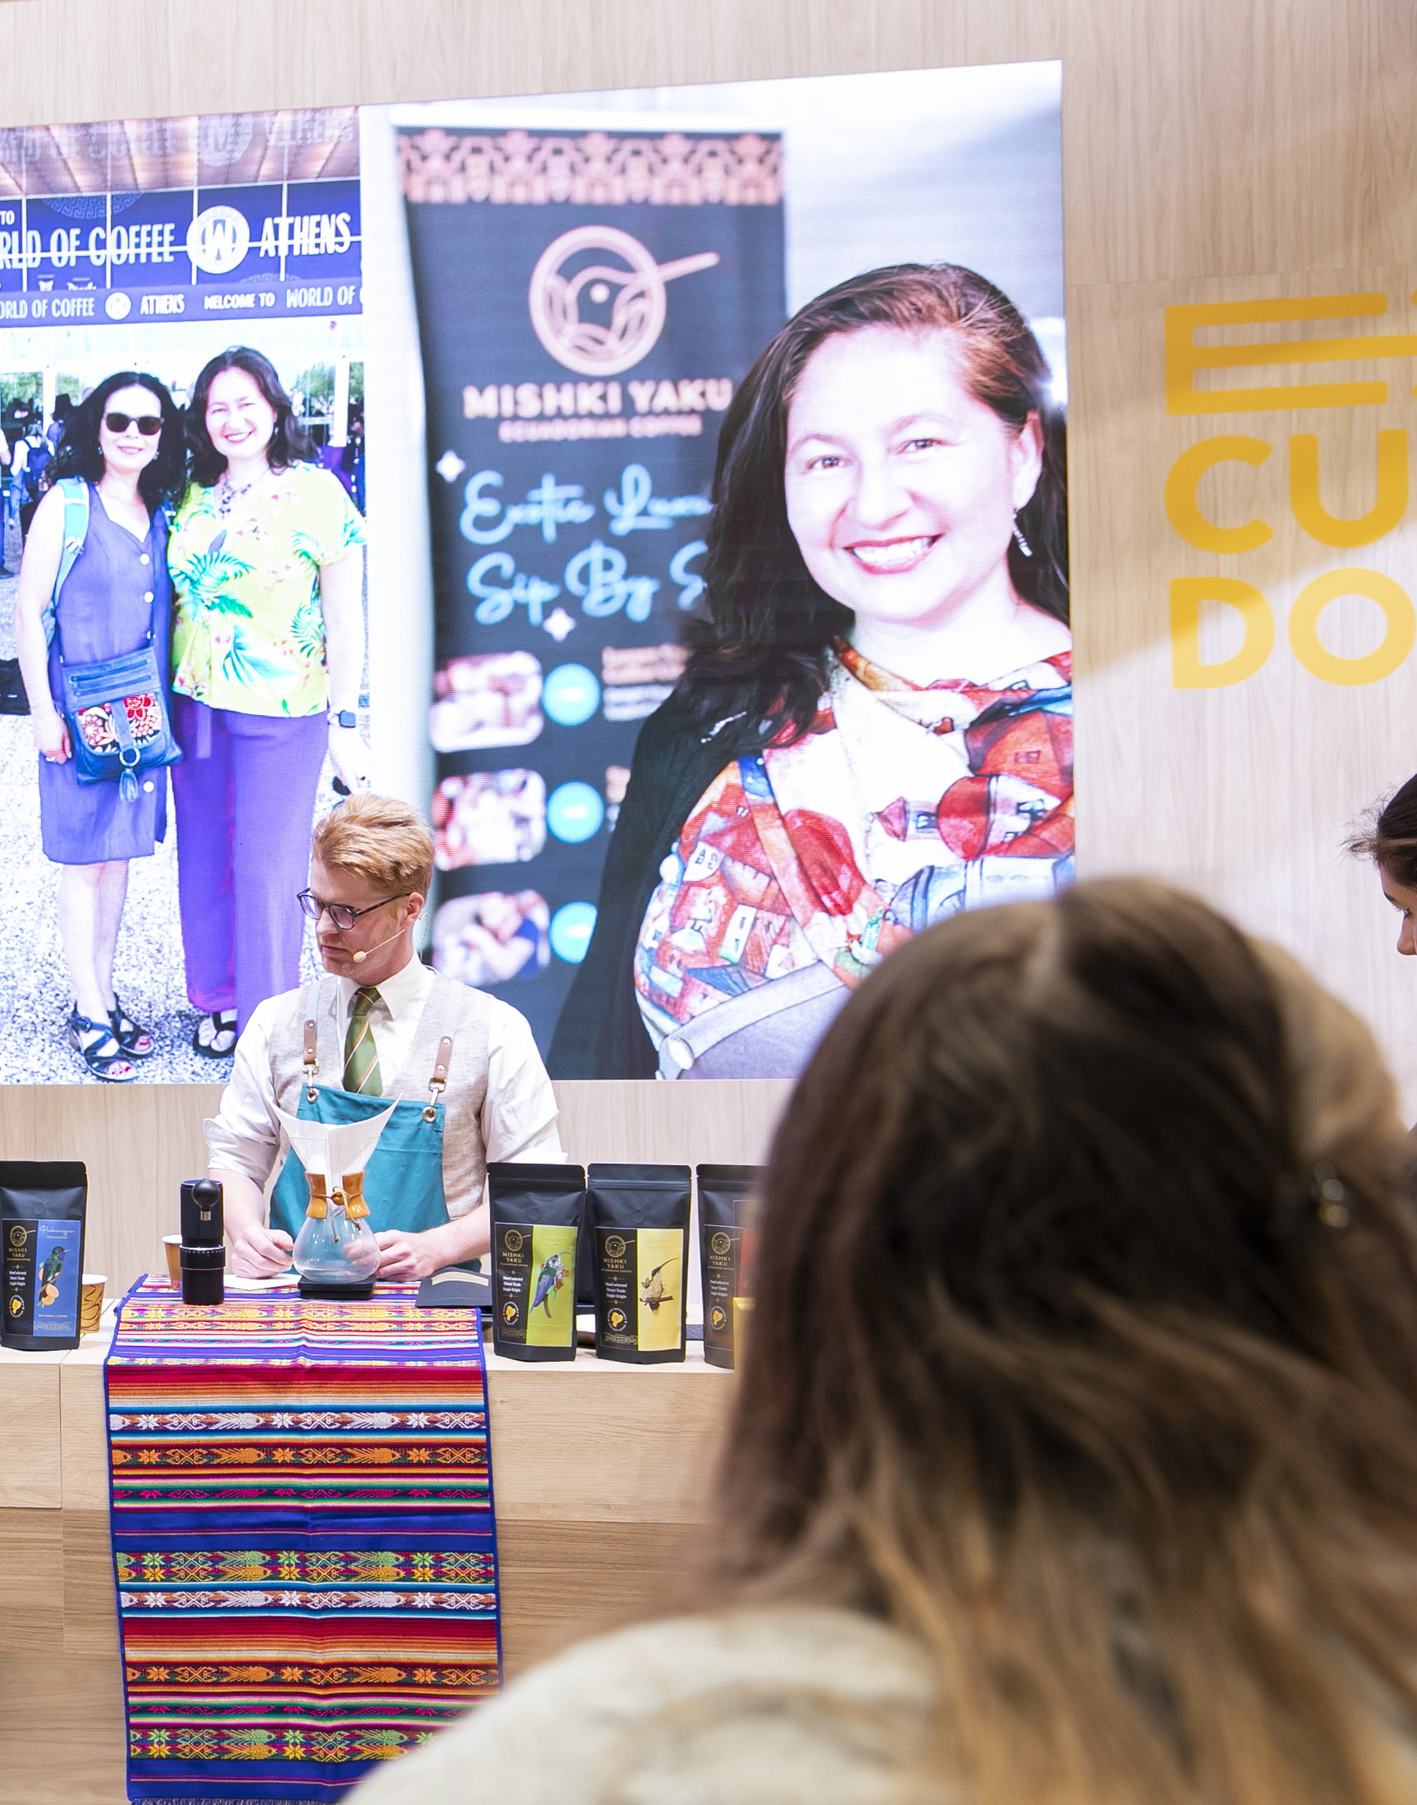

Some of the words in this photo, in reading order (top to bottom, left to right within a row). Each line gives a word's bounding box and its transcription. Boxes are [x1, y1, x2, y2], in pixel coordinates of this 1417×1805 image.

[0, 210, 15, 225] TO
[50, 228, 81, 267] OF
[88, 222, 175, 267] COFFEE
[259, 212, 352, 258] ATHENS
[32, 298, 48, 318] OF
[51, 297, 95, 318] COFFEE
[140, 294, 185, 315] ATHENS
[204, 294, 255, 310] WELCOME
[259, 292, 275, 307] TO
[286, 287, 333, 309] WORLD
[337, 285, 356, 306] OF
[463, 381, 622, 419] MISHKI
[628, 377, 733, 413] YAKU
